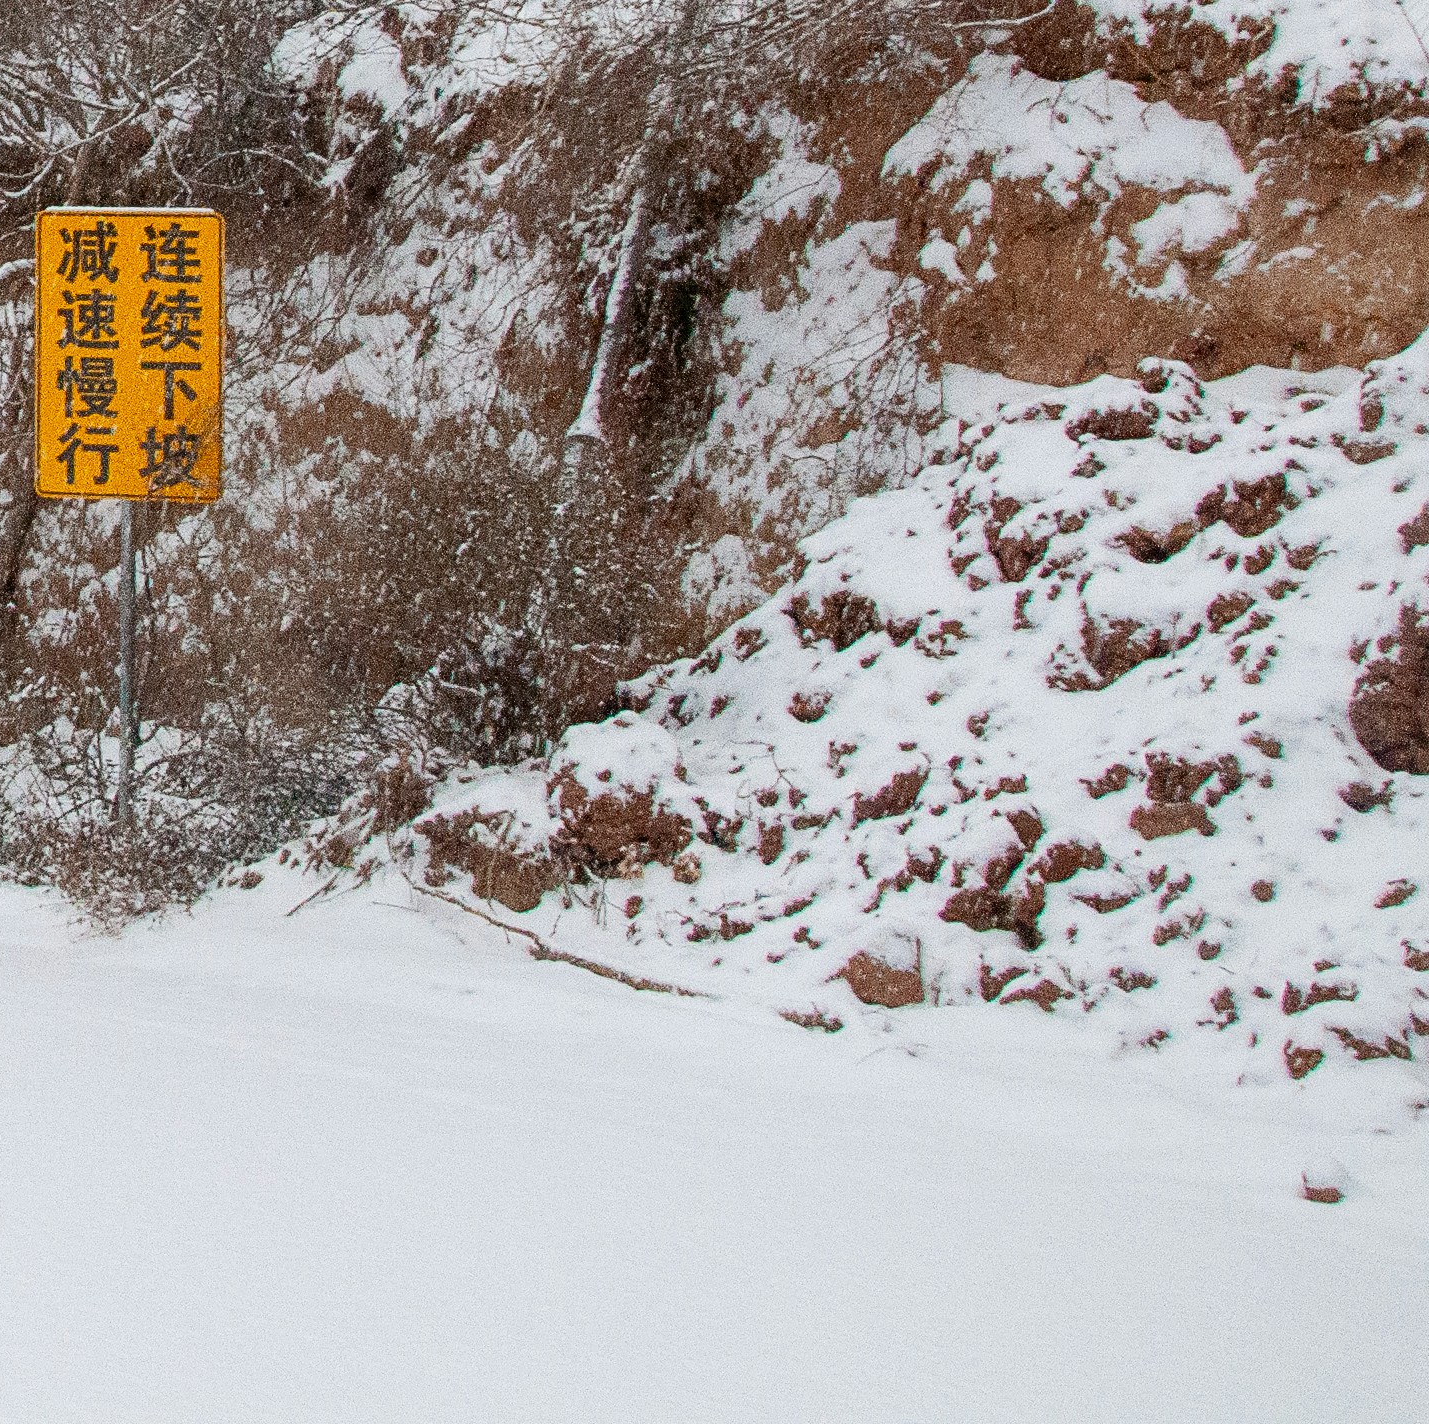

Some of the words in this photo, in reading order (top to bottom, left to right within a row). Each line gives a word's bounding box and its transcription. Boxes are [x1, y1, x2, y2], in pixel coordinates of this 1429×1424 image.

[56, 220, 120, 485] 减速慢行
[138, 222, 203, 488] 连续下坡
